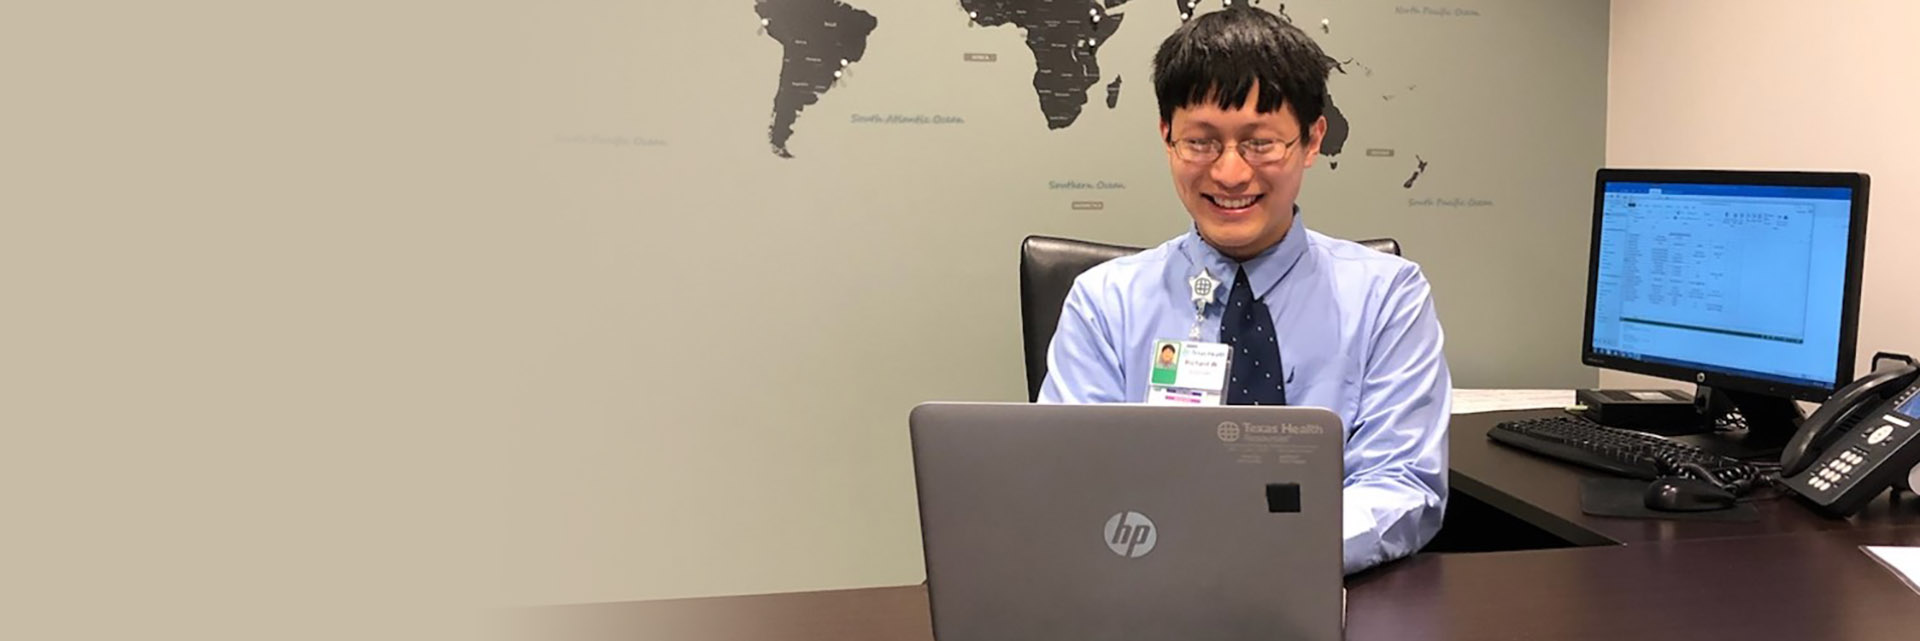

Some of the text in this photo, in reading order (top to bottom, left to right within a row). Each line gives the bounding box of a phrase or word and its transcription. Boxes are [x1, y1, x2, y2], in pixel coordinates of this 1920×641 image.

[850, 113, 966, 124] South Atlantic Ocean
[1048, 180, 1126, 190] Southern Ocean
[1243, 422, 1324, 435] Texas Health
[1111, 511, 1151, 557] hp
